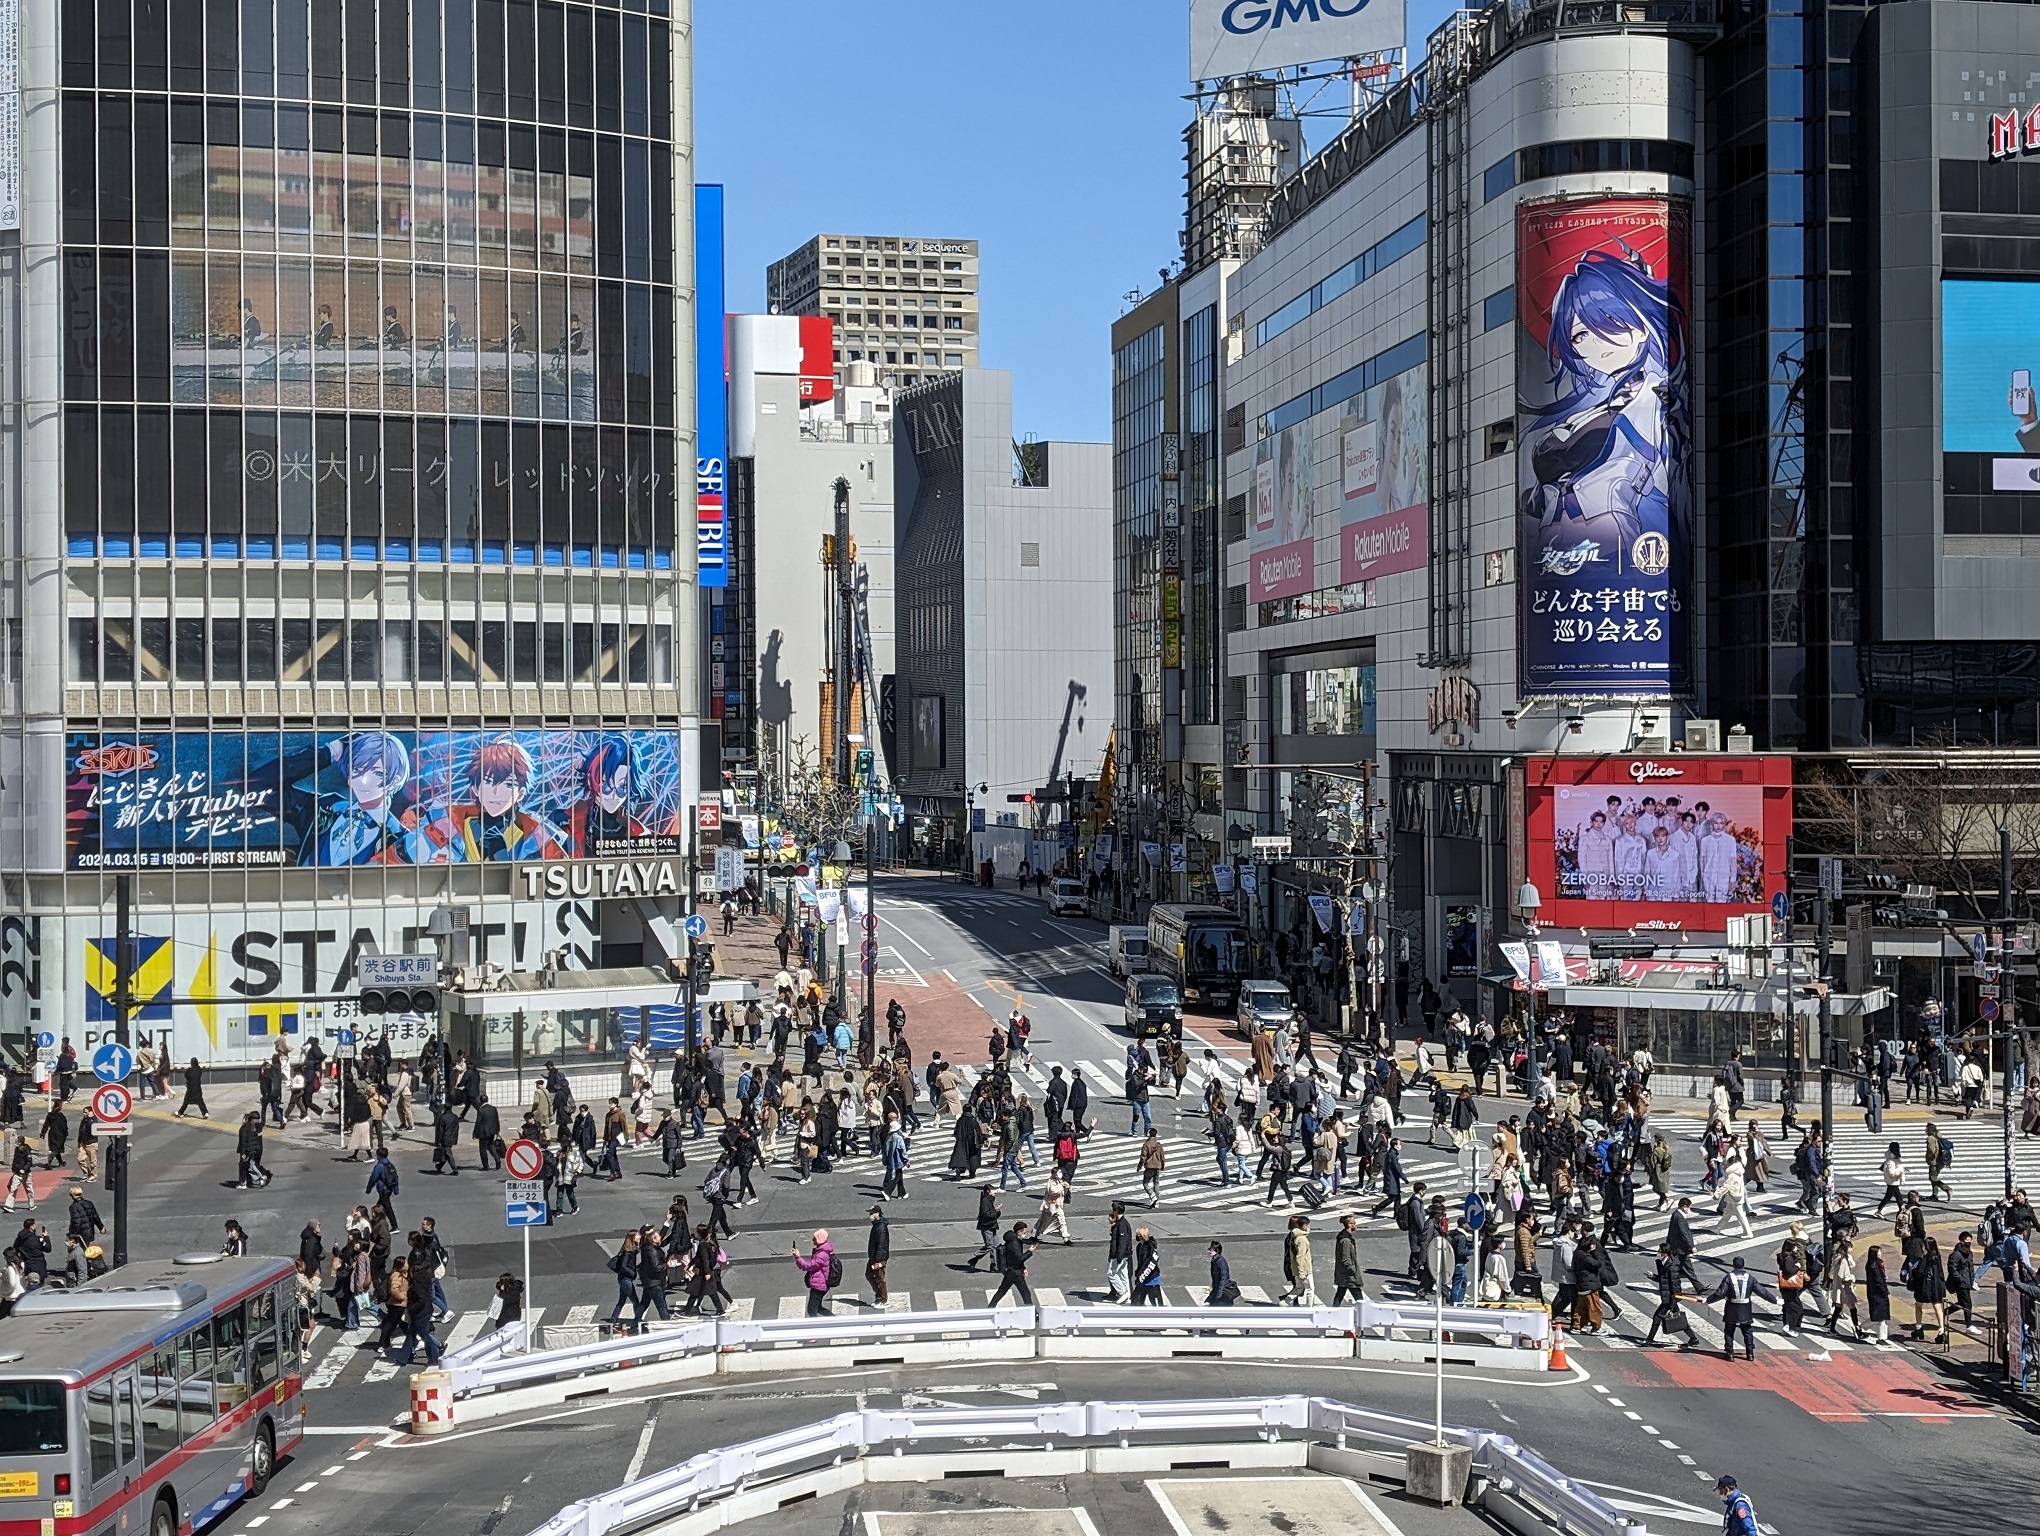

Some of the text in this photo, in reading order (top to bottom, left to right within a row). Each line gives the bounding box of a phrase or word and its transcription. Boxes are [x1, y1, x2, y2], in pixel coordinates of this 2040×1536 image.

[923, 243, 969, 254] sequence
[1165, 435, 1178, 473] 皮ふ科
[697, 457, 724, 564] SEIBU
[1165, 498, 1177, 524] 内科
[1259, 487, 1272, 517] No.1
[1354, 522, 1410, 562] Rakuten Mobile
[1260, 552, 1302, 585] Rakuten Mobile
[1532, 587, 1682, 614] どんな宇宙でも
[1553, 617, 1663, 644] 巡り会える
[882, 684, 895, 734] ZARA
[1629, 761, 1684, 784] Glico
[86, 770, 207, 809] にじさんじ
[700, 807, 717, 825] 本
[918, 797, 942, 816] ZARA
[184, 814, 277, 842] デビュー
[522, 861, 677, 897] TSUTAYA
[1560, 872, 1666, 888] ZEROBASEONE
[364, 957, 432, 974] 渋谷駅前
[374, 973, 424, 984] Shibuya Sta.
[85, 1028, 173, 1051] PONT
[512, 1192, 538, 1201] 6-22
